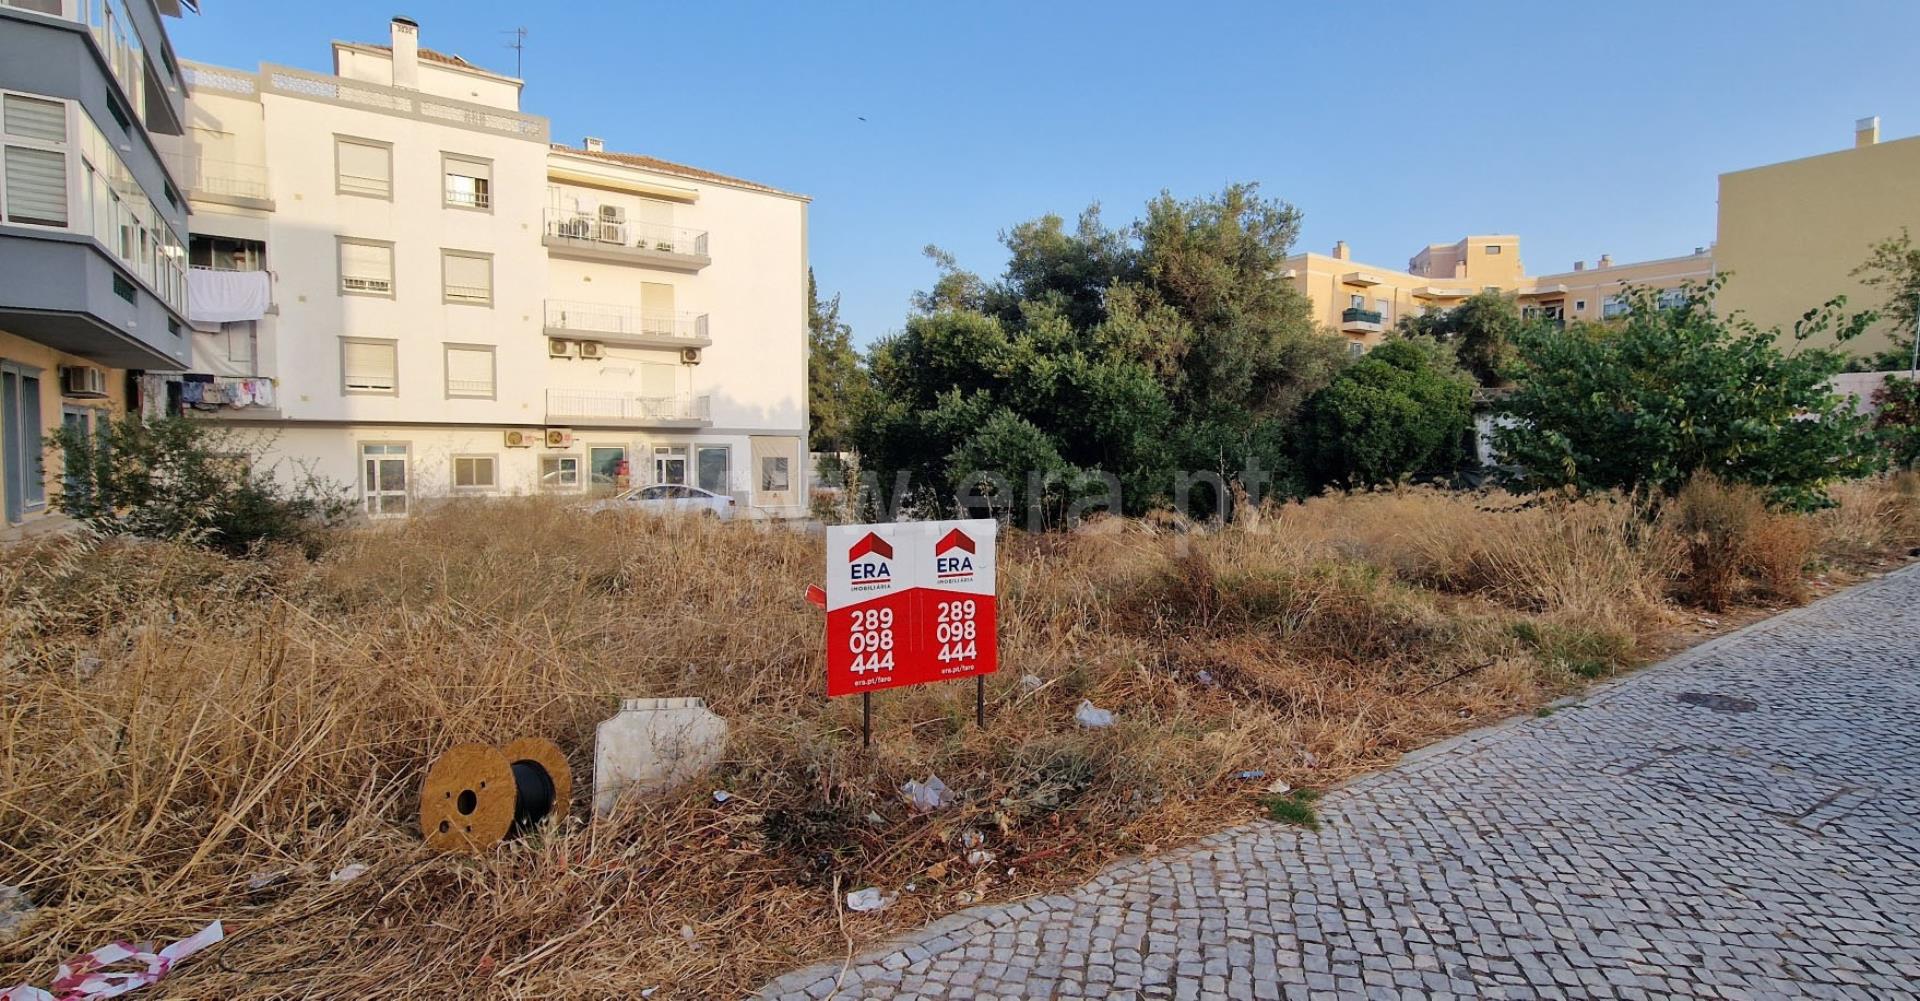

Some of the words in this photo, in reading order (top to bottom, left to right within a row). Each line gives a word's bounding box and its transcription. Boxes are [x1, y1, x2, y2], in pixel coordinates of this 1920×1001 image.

[851, 562, 891, 580] ERA
[937, 556, 973, 573] ERA
[851, 607, 893, 632] 289
[938, 600, 976, 623] 289
[849, 629, 894, 654] 098
[936, 620, 976, 643] 098
[850, 651, 895, 674] 444
[937, 641, 977, 663] 444
[854, 676, 892, 686] era.pt/faro
